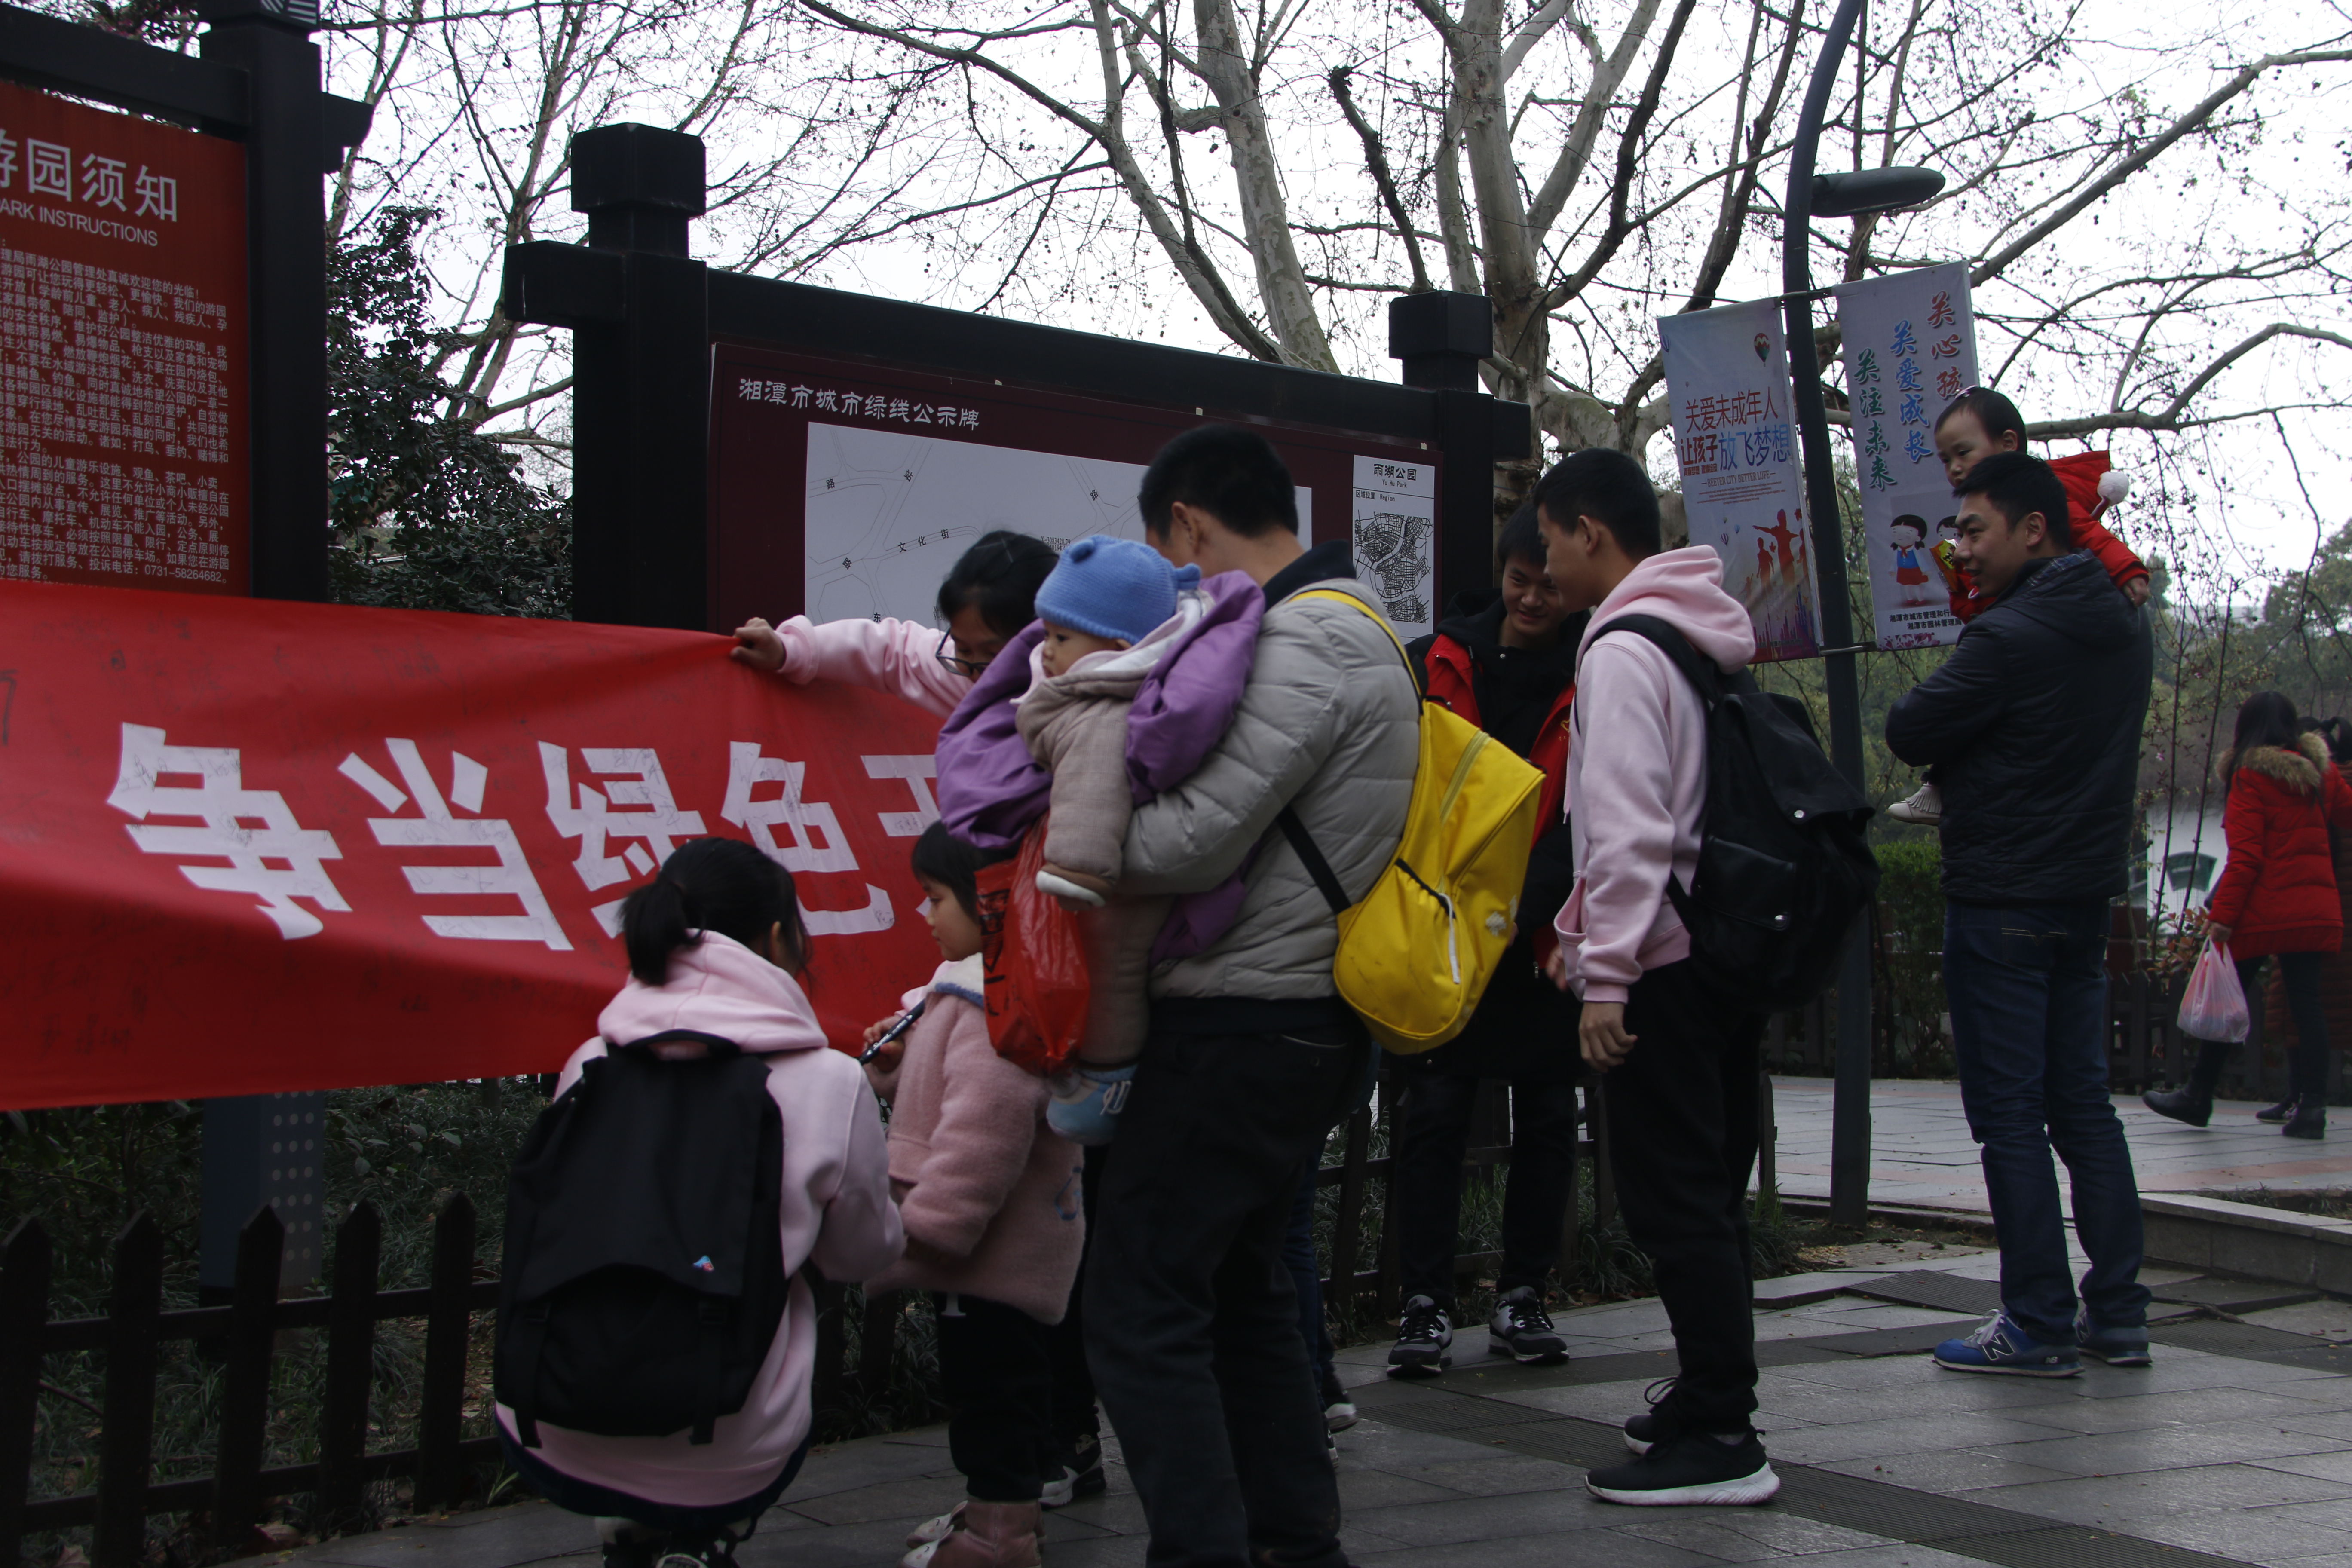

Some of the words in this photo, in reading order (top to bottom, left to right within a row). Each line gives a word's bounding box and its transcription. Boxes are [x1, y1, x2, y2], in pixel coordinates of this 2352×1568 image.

[40, 206, 158, 246] INSTRUCTIONS
[0, 319, 227, 371] 能携带易燃、易爆物品、枪支以及家禽和宠物
[0, 335, 221, 383] 生火野餐，燃放鞭炮烟花；不要在园内烧包、
[1927, 291, 1963, 400] 关心孩
[0, 348, 227, 398] ；不要在水域游泳洗澡、洗衣、洗菜以及其他
[1890, 320, 1933, 463] 关爱成长
[739, 378, 979, 430] 湘潭市城市绿线公示牌
[1685, 387, 1778, 433] 关爱未成年人
[1853, 348, 1896, 490] 关注未来
[1680, 424, 1791, 471] 让孩子放飞梦想
[826, 478, 835, 490] 路
[904, 469, 913, 482] 站
[1373, 464, 1417, 481] 雨湖公园
[1726, 475, 1737, 484] CITY
[1738, 472, 1758, 482] BETTER
[1356, 490, 1375, 500] 区域位置
[873, 612, 881, 623] 东
[1889, 609, 1952, 622] 湘潭市城市管理和行
[1982, 1333, 2015, 1361] N
